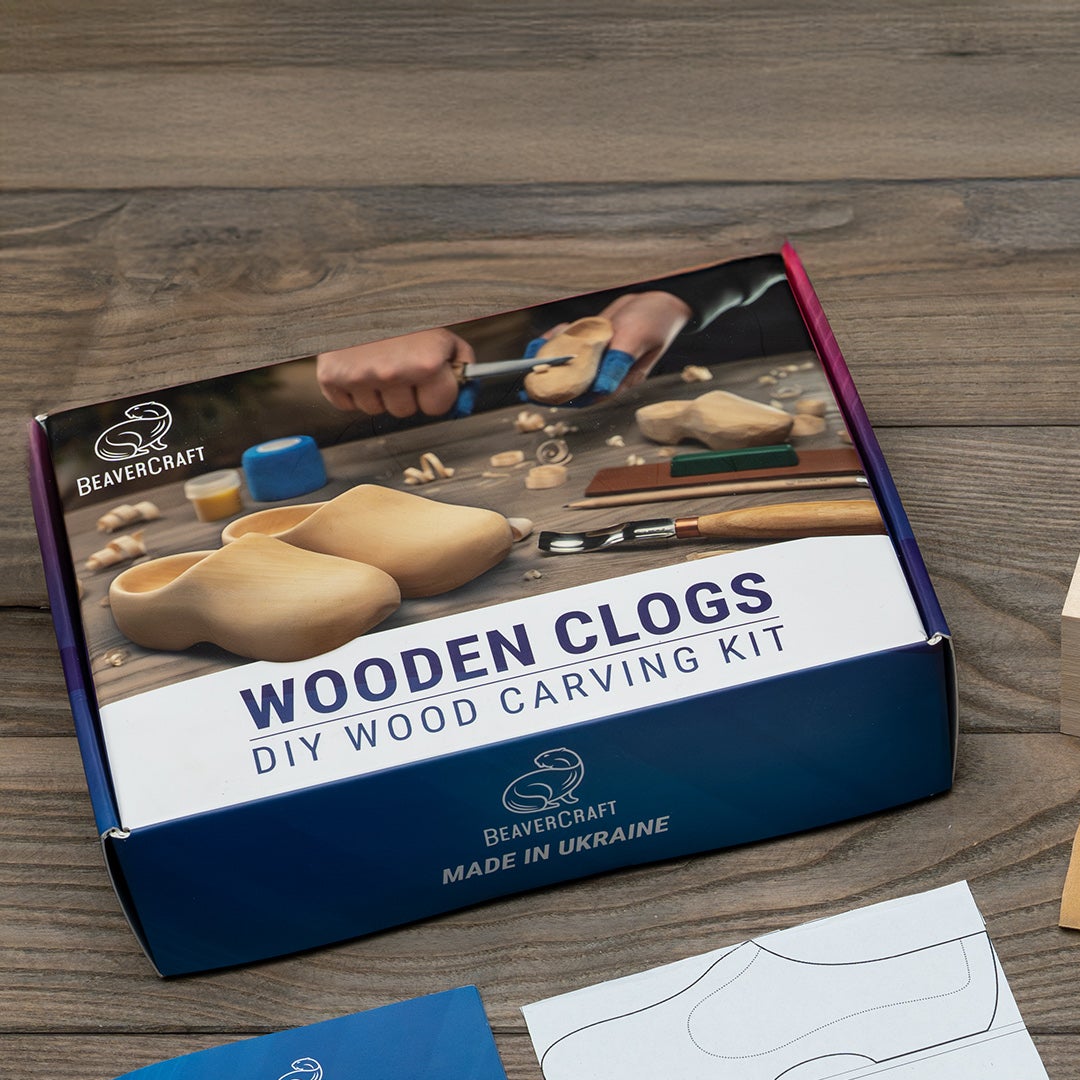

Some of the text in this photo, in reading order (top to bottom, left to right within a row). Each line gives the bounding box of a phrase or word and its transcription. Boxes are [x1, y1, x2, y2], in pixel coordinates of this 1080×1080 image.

[240, 573, 772, 729] WOODEN CLOGS
[253, 625, 783, 774] DIY WOOD CARVING KIT
[443, 816, 669, 884] MADE IN UKRAINE
